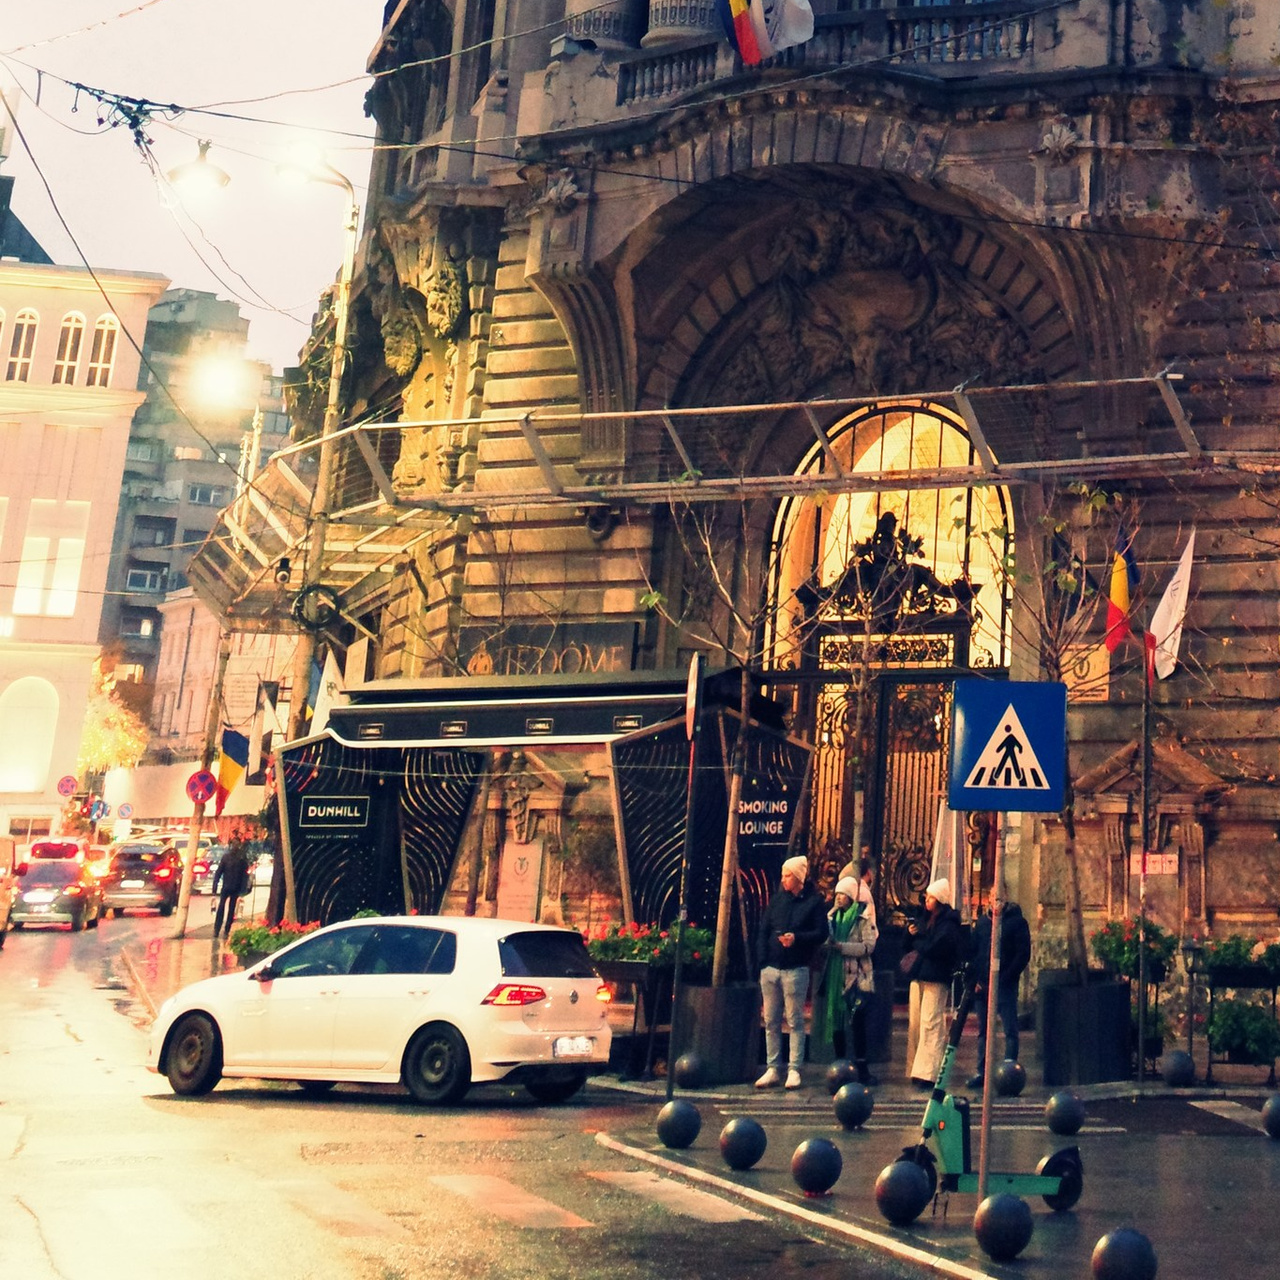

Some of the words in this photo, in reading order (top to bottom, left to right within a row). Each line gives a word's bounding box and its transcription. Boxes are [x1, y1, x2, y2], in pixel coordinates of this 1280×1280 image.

[307, 806, 361, 817] DUNHILL
[738, 800, 788, 814] SMOKING
[739, 821, 784, 835] LOUNGE
